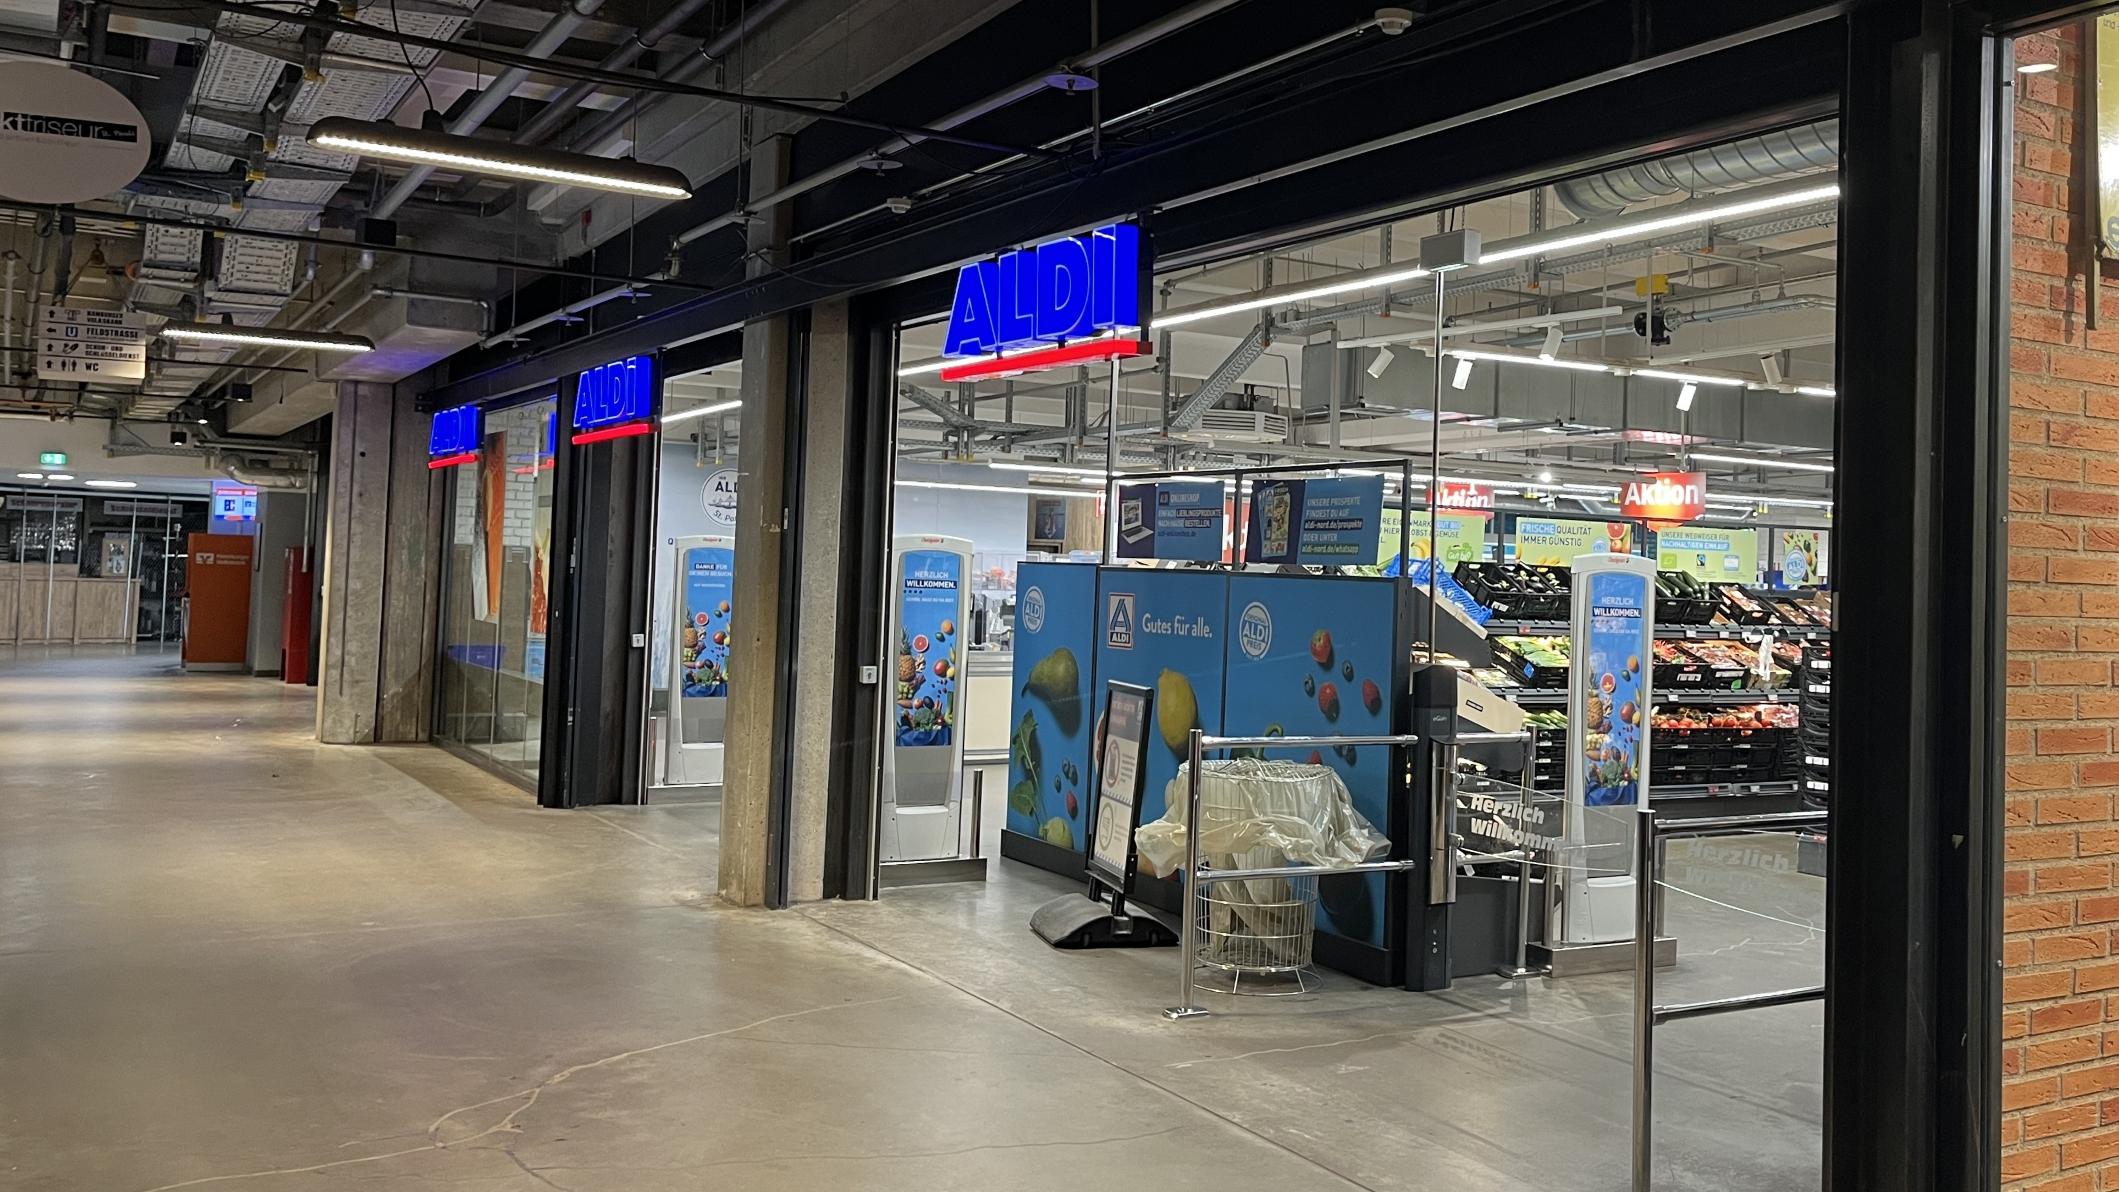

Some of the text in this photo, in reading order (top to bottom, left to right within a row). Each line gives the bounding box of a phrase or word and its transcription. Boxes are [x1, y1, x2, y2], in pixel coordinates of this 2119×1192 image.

[942, 224, 1138, 358] ALDI
[86, 327, 138, 339] FELDSTRASSE
[85, 362, 99, 371] WC
[573, 356, 653, 427] ALDI
[1624, 477, 1699, 506] Aktion
[1384, 527, 1400, 535] HIER
[1520, 523, 1555, 534] FRISCHE
[1520, 536, 1582, 547] IMMER GÜNSTIG
[914, 570, 949, 579] HERZLICH
[906, 580, 956, 589] WILLKOMMEN.
[1601, 596, 1634, 606] HERZLICH
[1593, 607, 1641, 618] WILLKOMMEN.
[1142, 613, 1213, 638] Gutes für alle.
[1111, 632, 1131, 643] ALDI
[1242, 621, 1269, 643] ALDI
[1470, 795, 1545, 825] Herzlich
